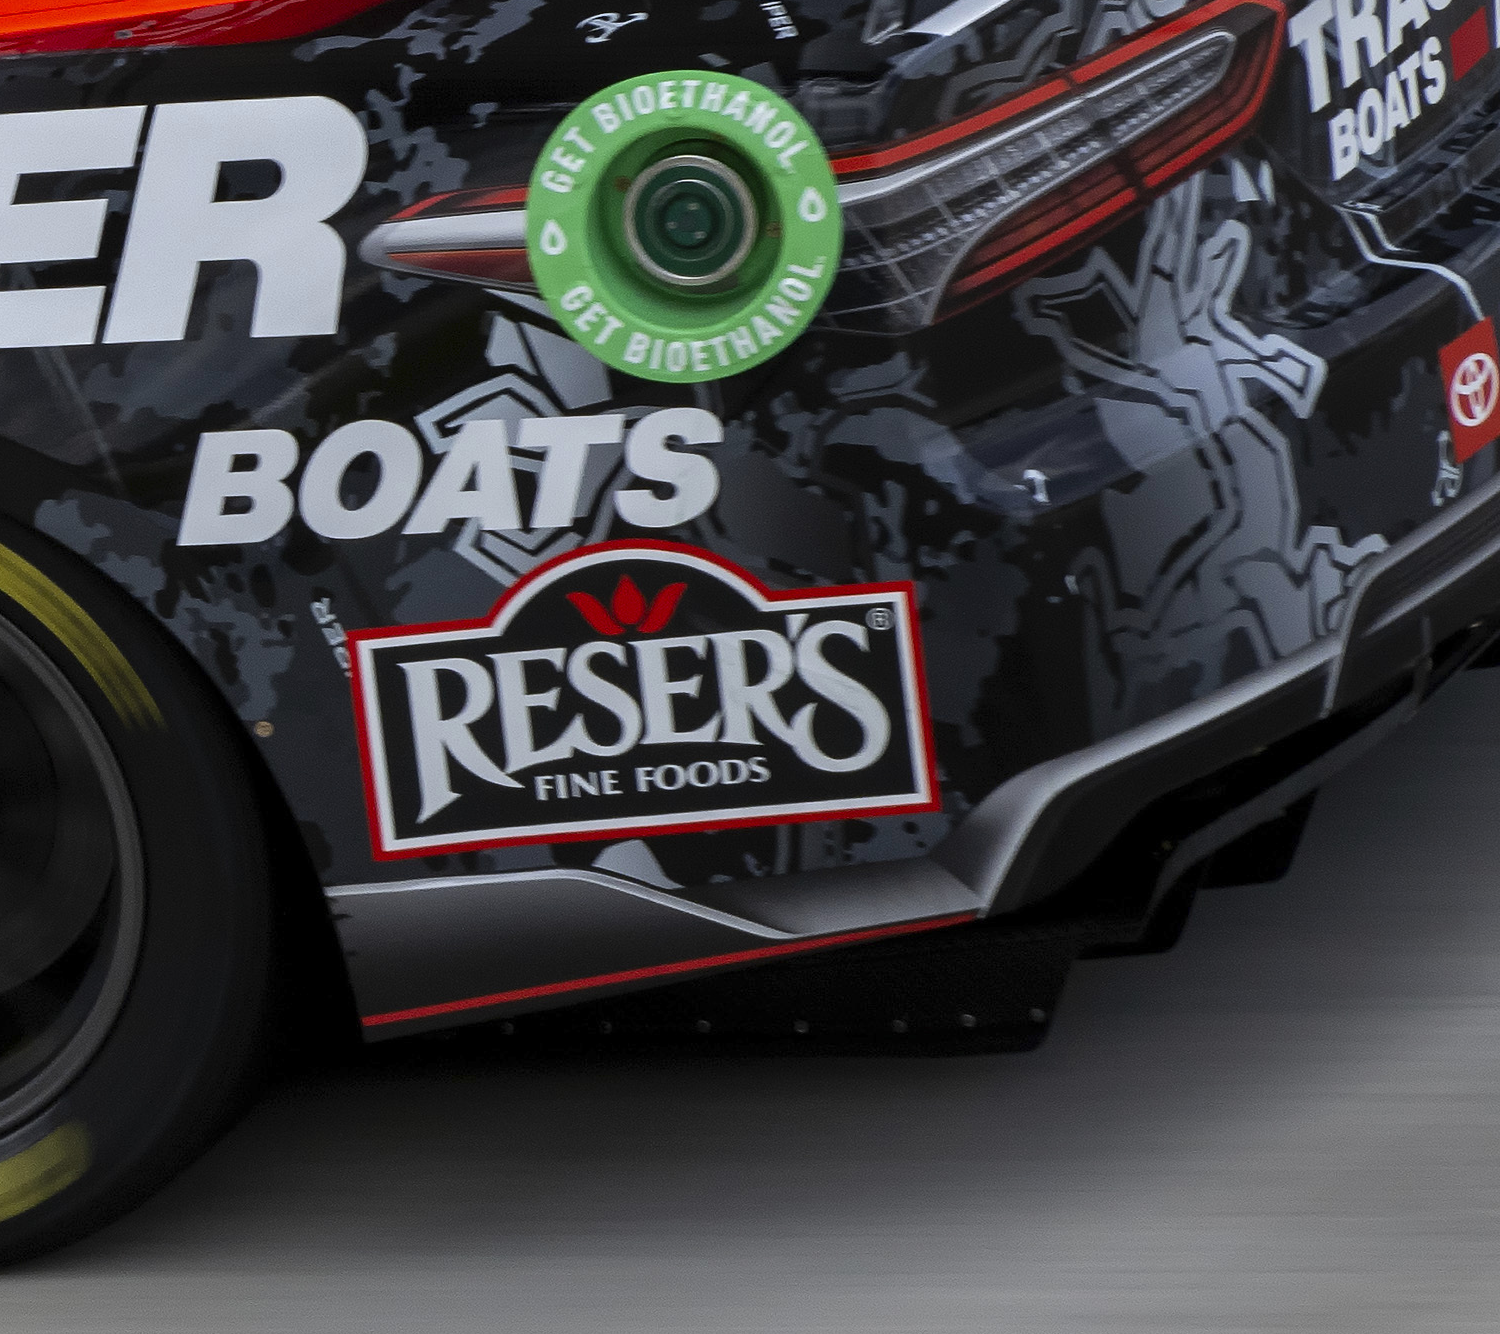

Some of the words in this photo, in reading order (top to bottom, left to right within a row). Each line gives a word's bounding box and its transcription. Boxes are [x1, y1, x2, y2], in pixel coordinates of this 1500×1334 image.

[540, 127, 597, 193] GET
[590, 79, 809, 175] BIOETHANOL
[1329, 36, 1448, 181] BOATS
[560, 285, 625, 345] GET
[622, 261, 826, 373] BIOETHANOL
[176, 407, 724, 547] BOATS
[400, 613, 894, 824] RESER'S
[534, 765, 622, 803] FINE
[636, 755, 771, 793] FOODS
